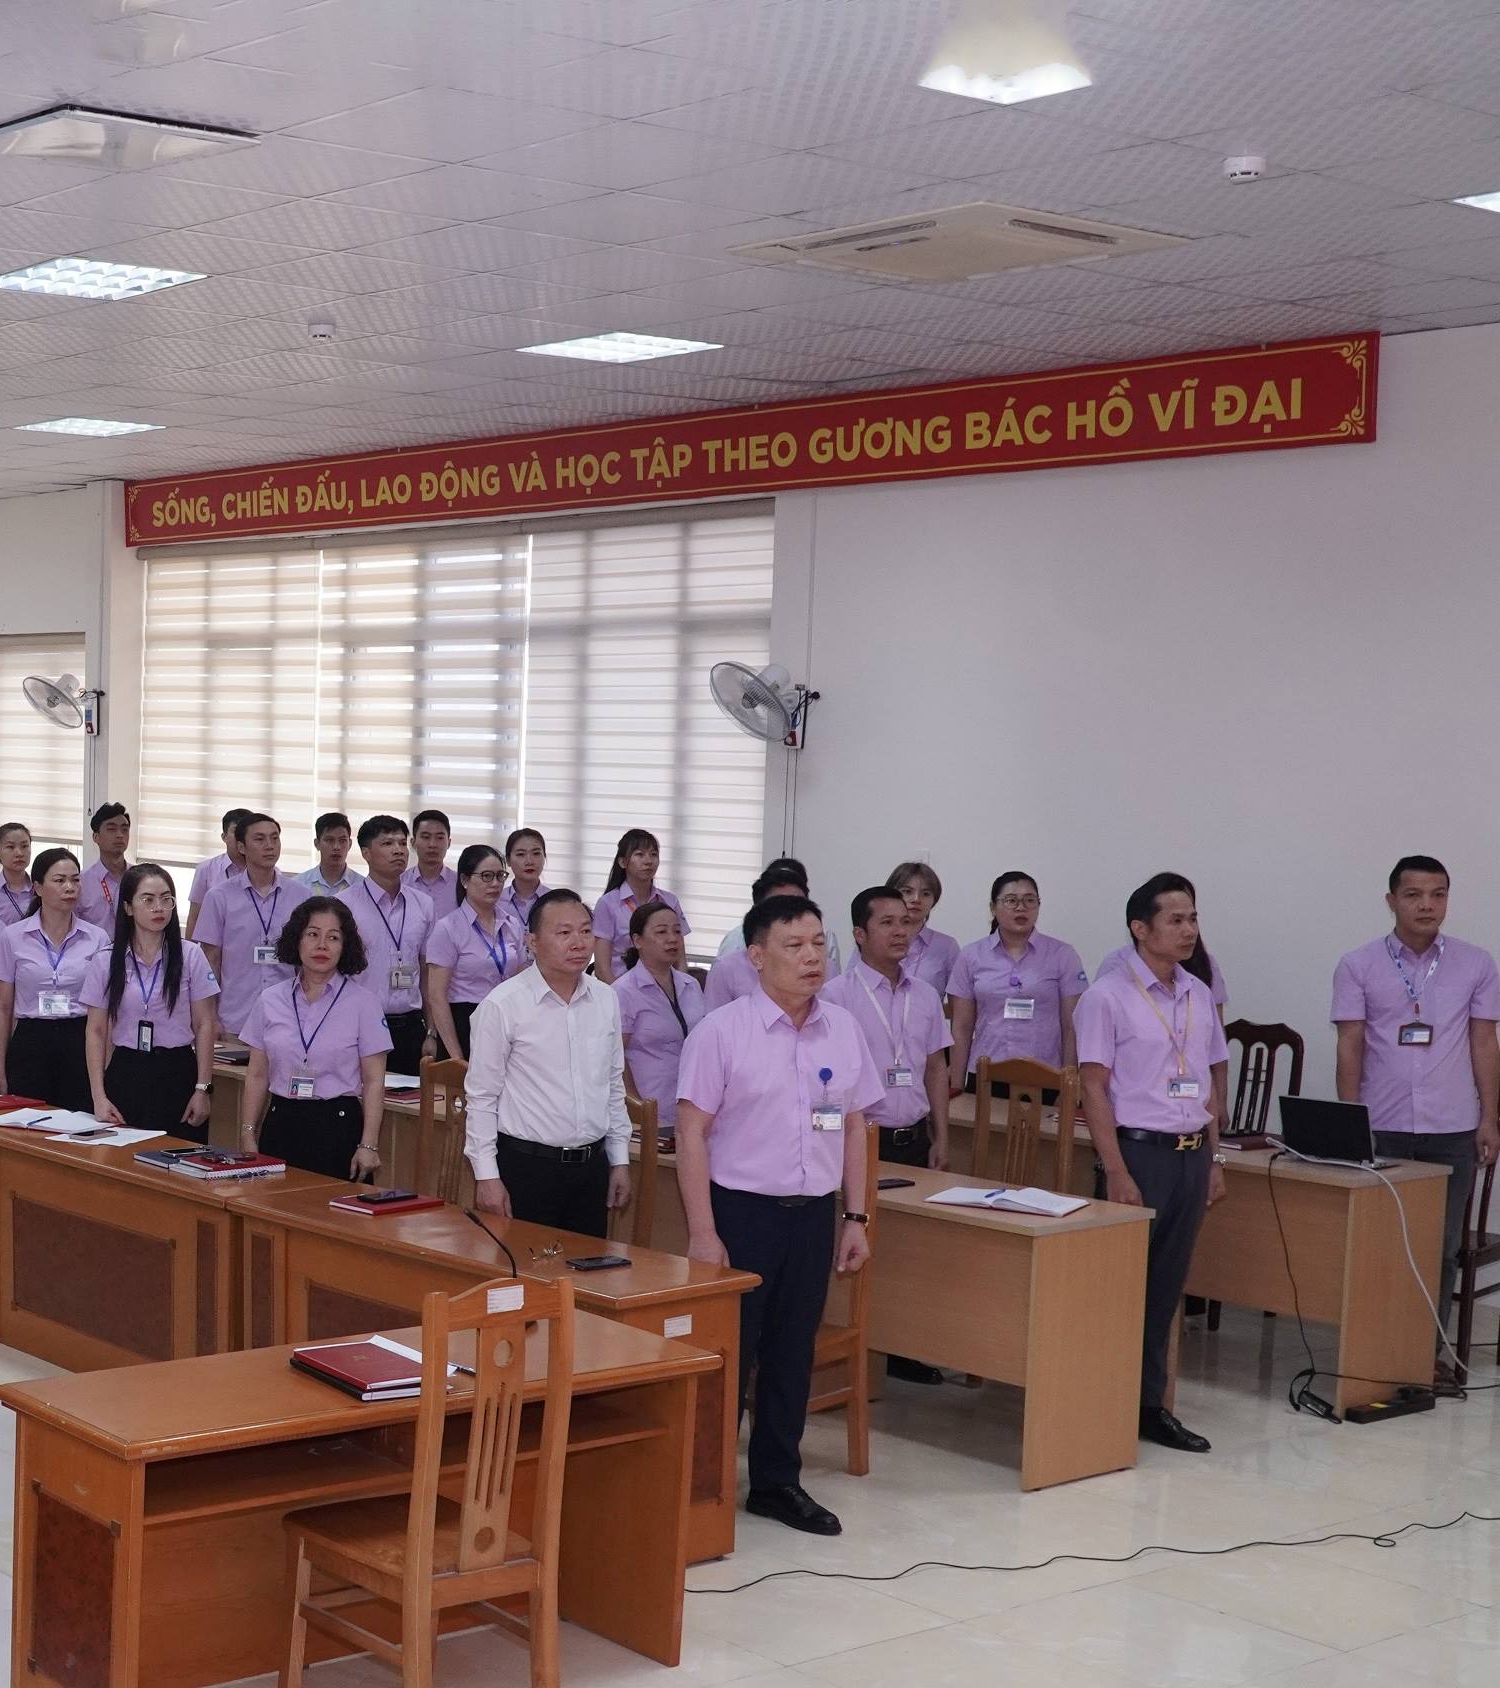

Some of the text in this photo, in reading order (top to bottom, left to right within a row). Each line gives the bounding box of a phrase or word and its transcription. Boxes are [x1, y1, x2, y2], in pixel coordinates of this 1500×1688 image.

[152, 378, 1302, 527] SỐNG, CHIẾN ĐẤU, LAO ĐỘNG VÀ HỌC TẬP THEO GƯƠNG BÁC HỒ VĨ ĐẠI
